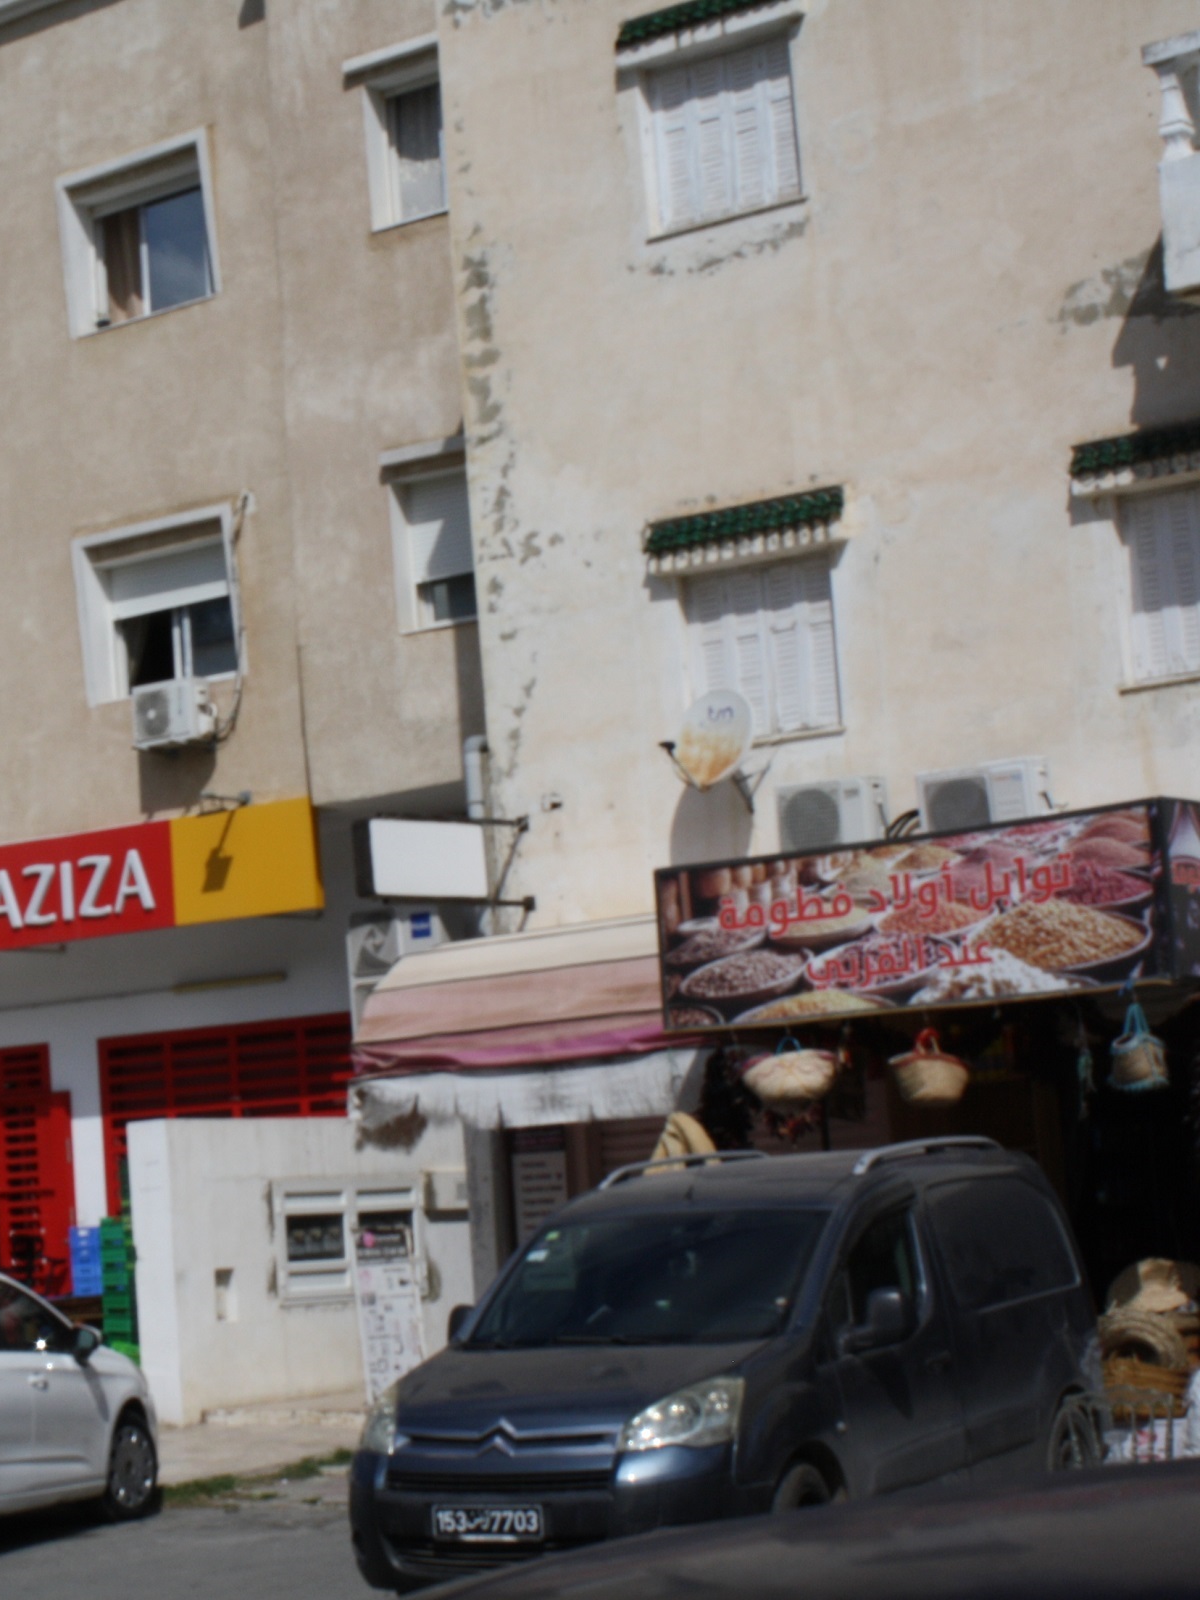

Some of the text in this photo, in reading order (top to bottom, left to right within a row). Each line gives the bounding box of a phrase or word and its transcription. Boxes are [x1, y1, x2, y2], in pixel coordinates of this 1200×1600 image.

[719, 853, 1073, 938] توابل أولاد فطومة
[939, 935, 992, 968] عند
[437, 1510, 466, 1532] 153
[491, 1510, 538, 1532] 7703
